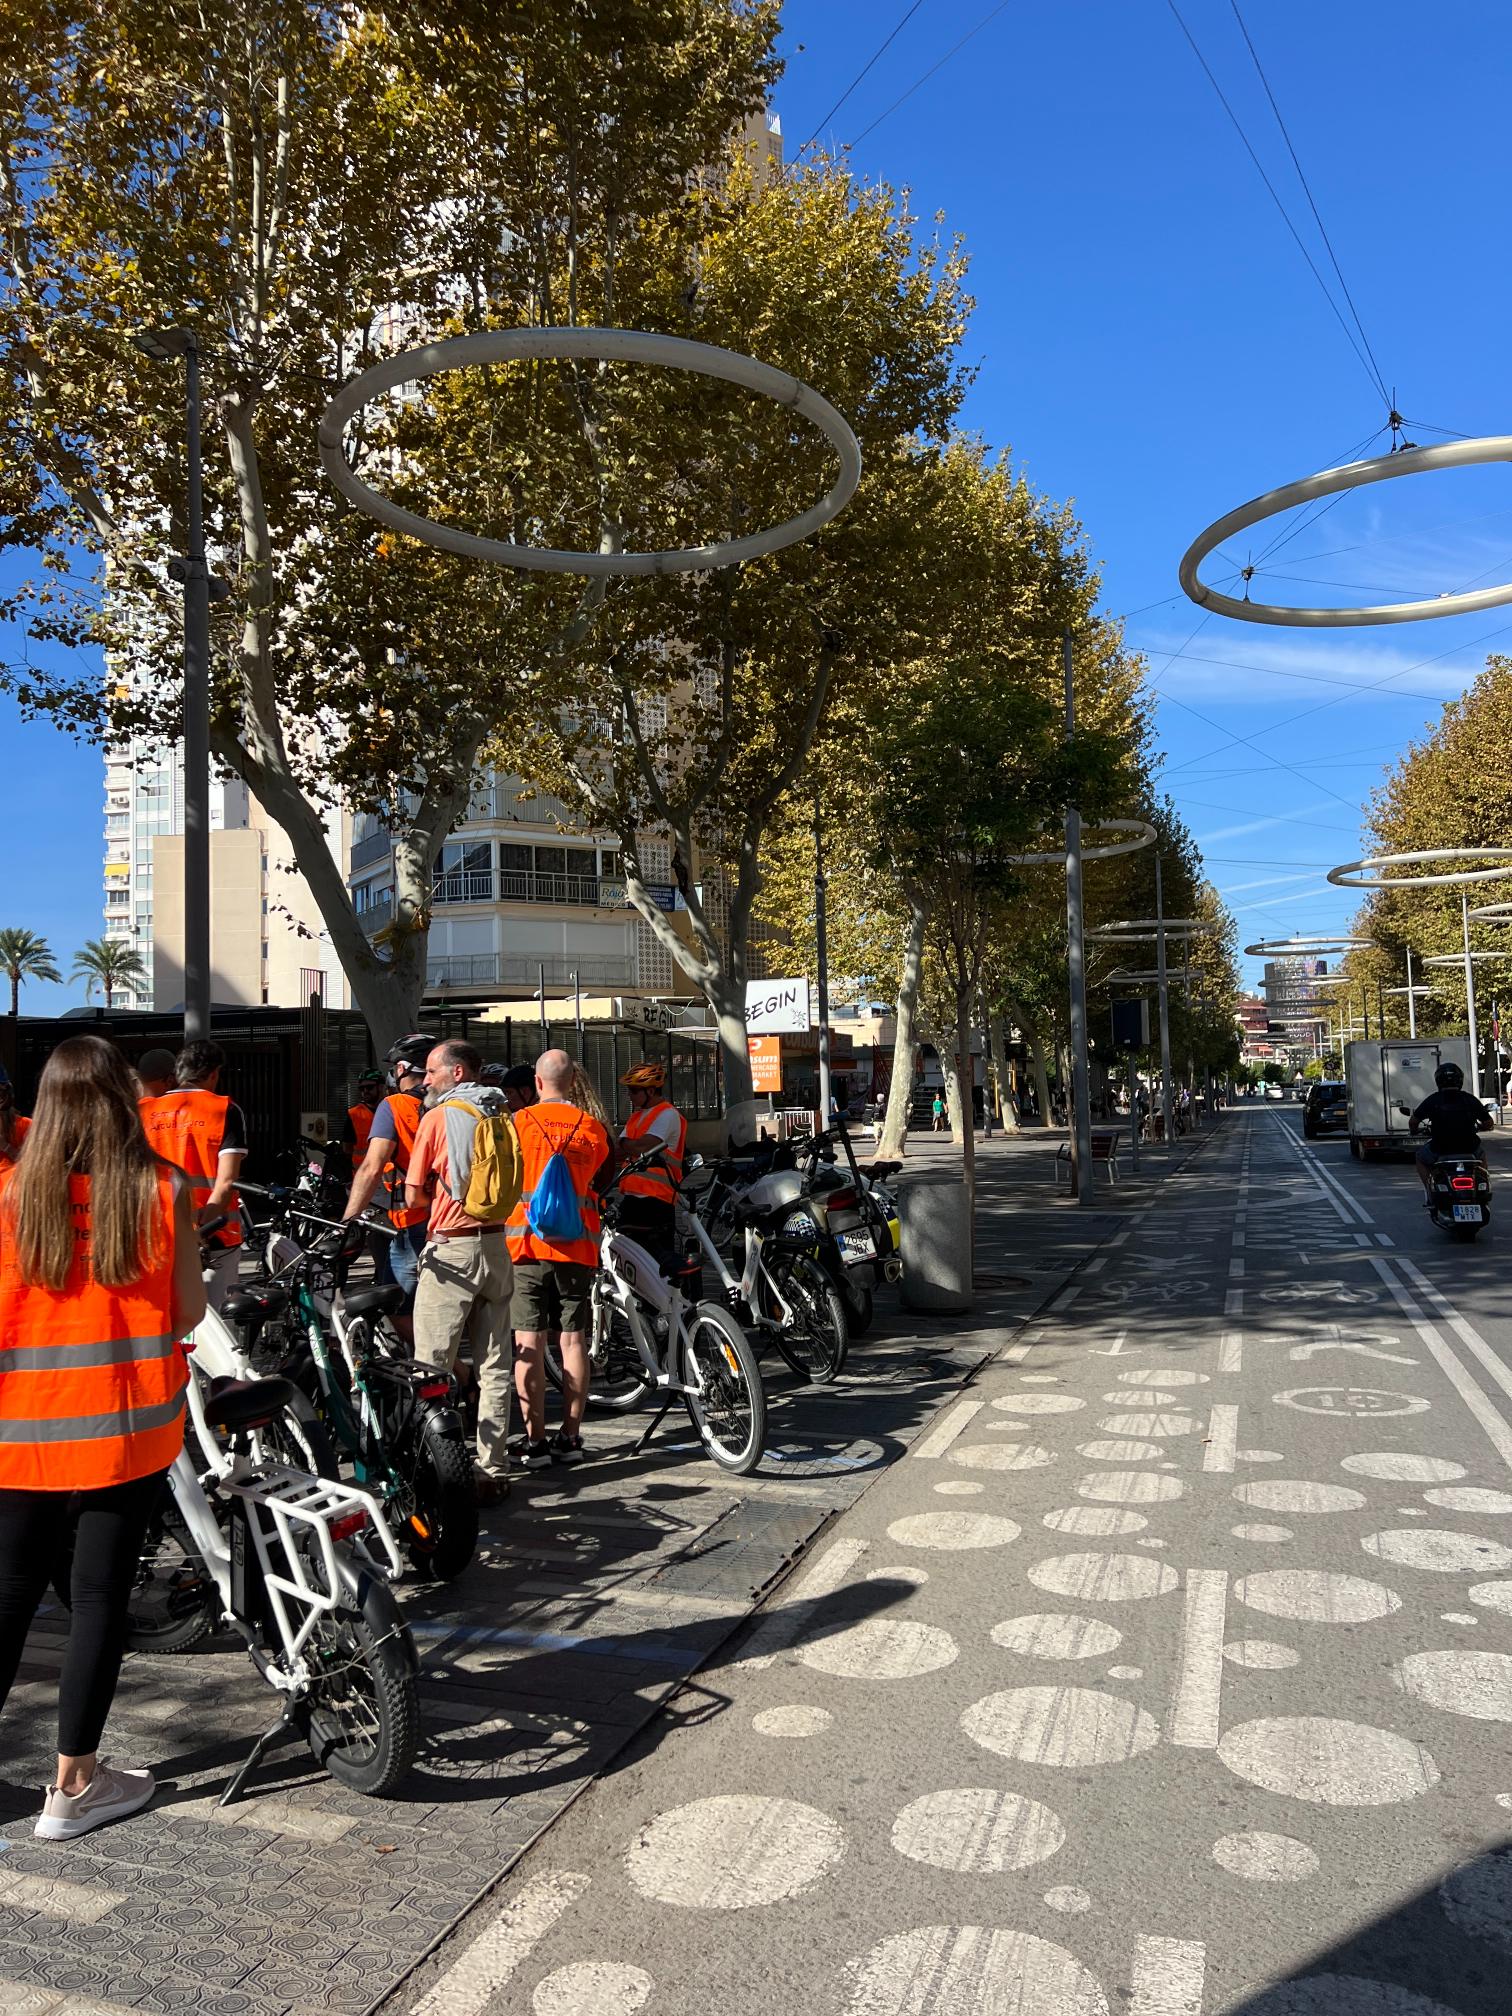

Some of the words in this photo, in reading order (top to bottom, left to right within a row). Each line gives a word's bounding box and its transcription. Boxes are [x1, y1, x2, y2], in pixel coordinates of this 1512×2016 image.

[744, 987, 797, 1022] BEGIN
[845, 1230, 869, 1245] 2695
[853, 1242, 870, 1256] JBX
